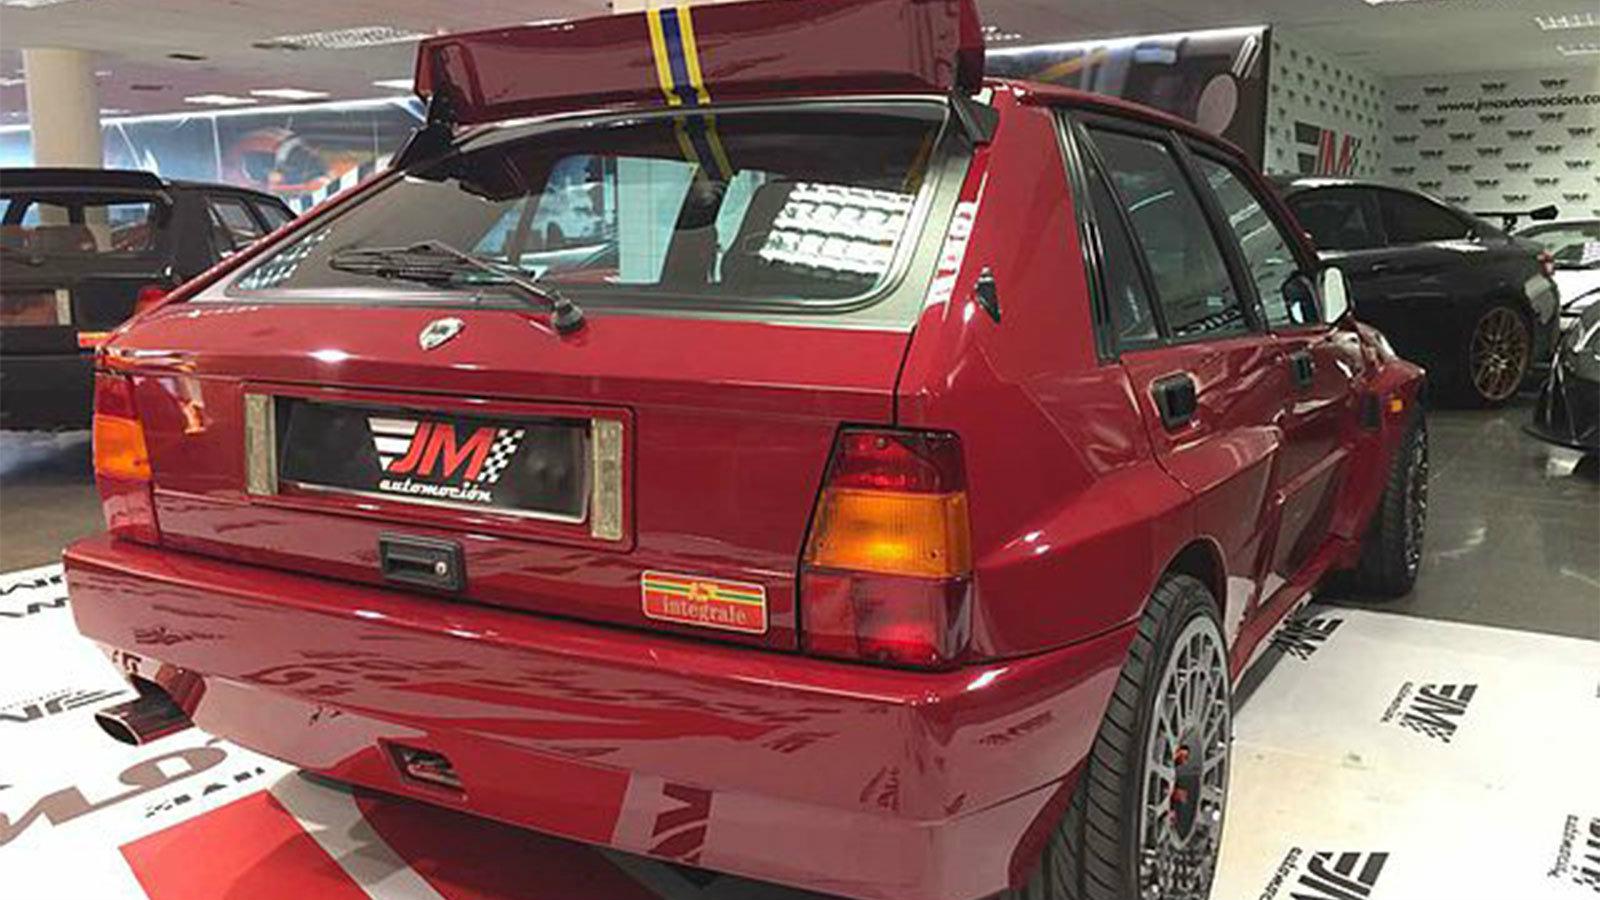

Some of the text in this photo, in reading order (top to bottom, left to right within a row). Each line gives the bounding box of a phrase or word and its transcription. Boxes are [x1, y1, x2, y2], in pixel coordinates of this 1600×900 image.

[390, 421, 497, 481] JM
[379, 478, 493, 502] automoción
[663, 596, 747, 624] integrale
[1403, 686, 1468, 732] JM
